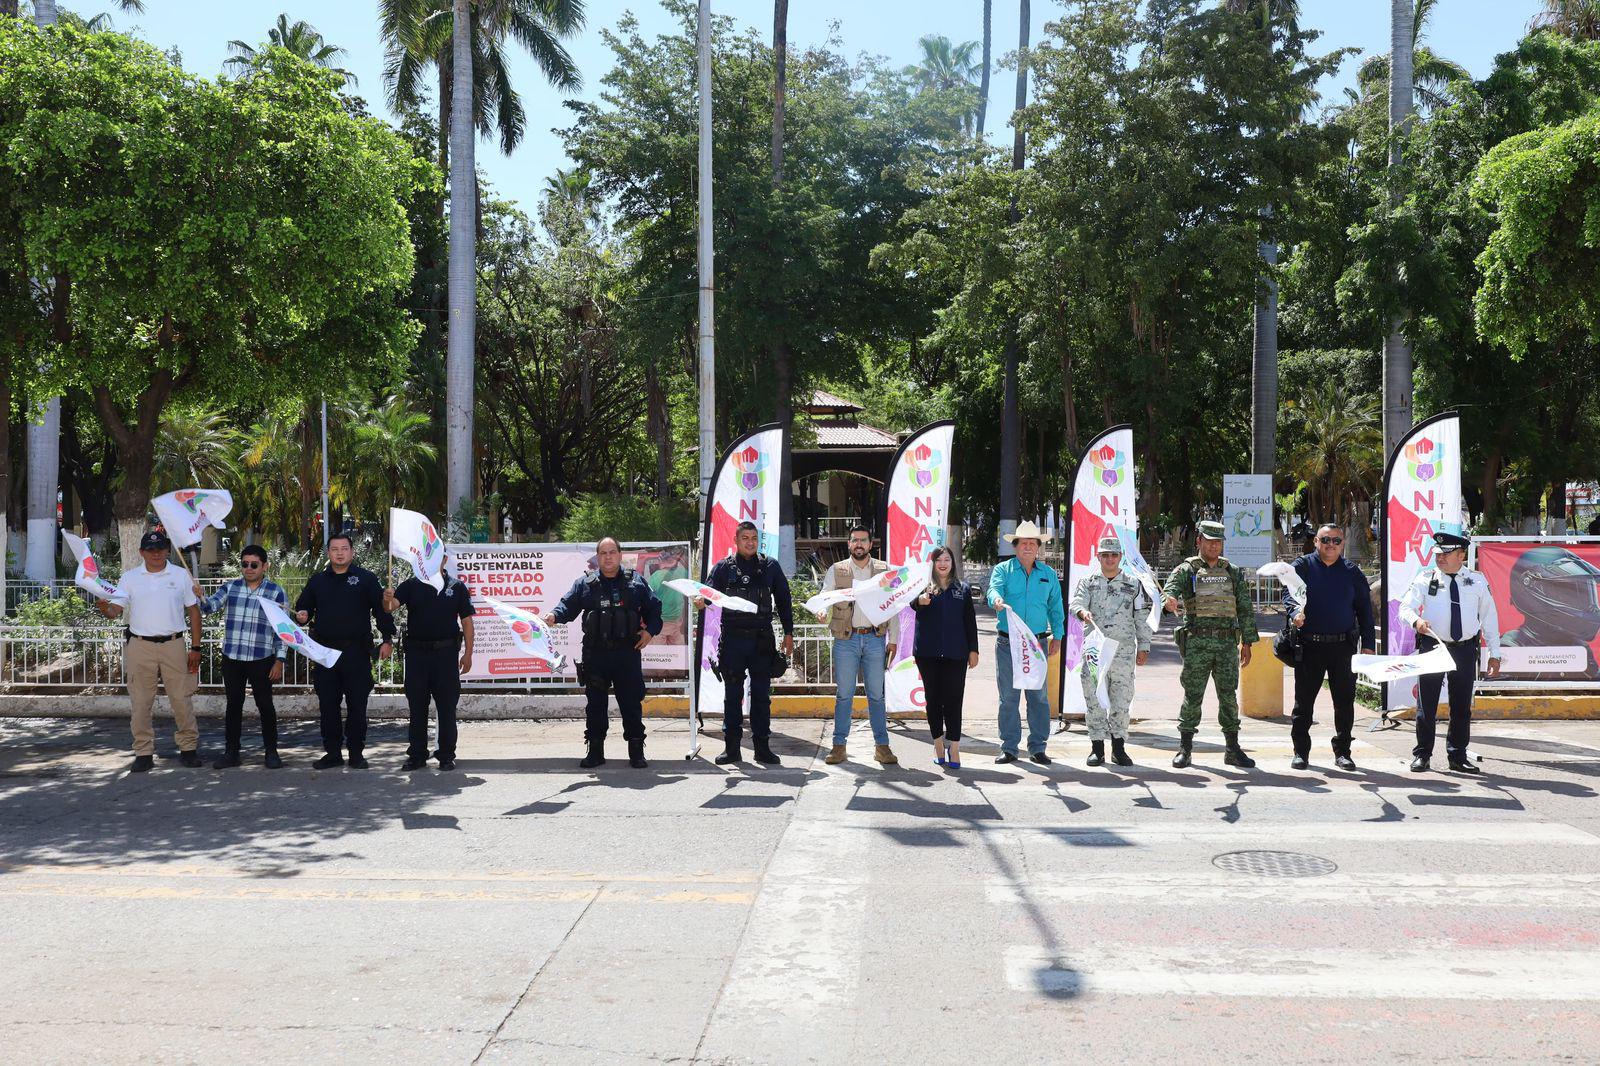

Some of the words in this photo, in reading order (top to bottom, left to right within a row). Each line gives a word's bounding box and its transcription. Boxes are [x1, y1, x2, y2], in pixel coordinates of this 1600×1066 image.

[1225, 496, 1271, 507] Integridad
[456, 561, 544, 571] SUSTENTABLE
[457, 574, 485, 584] DEL
[487, 573, 544, 583] ESTADO
[480, 586, 543, 596] SINALOA
